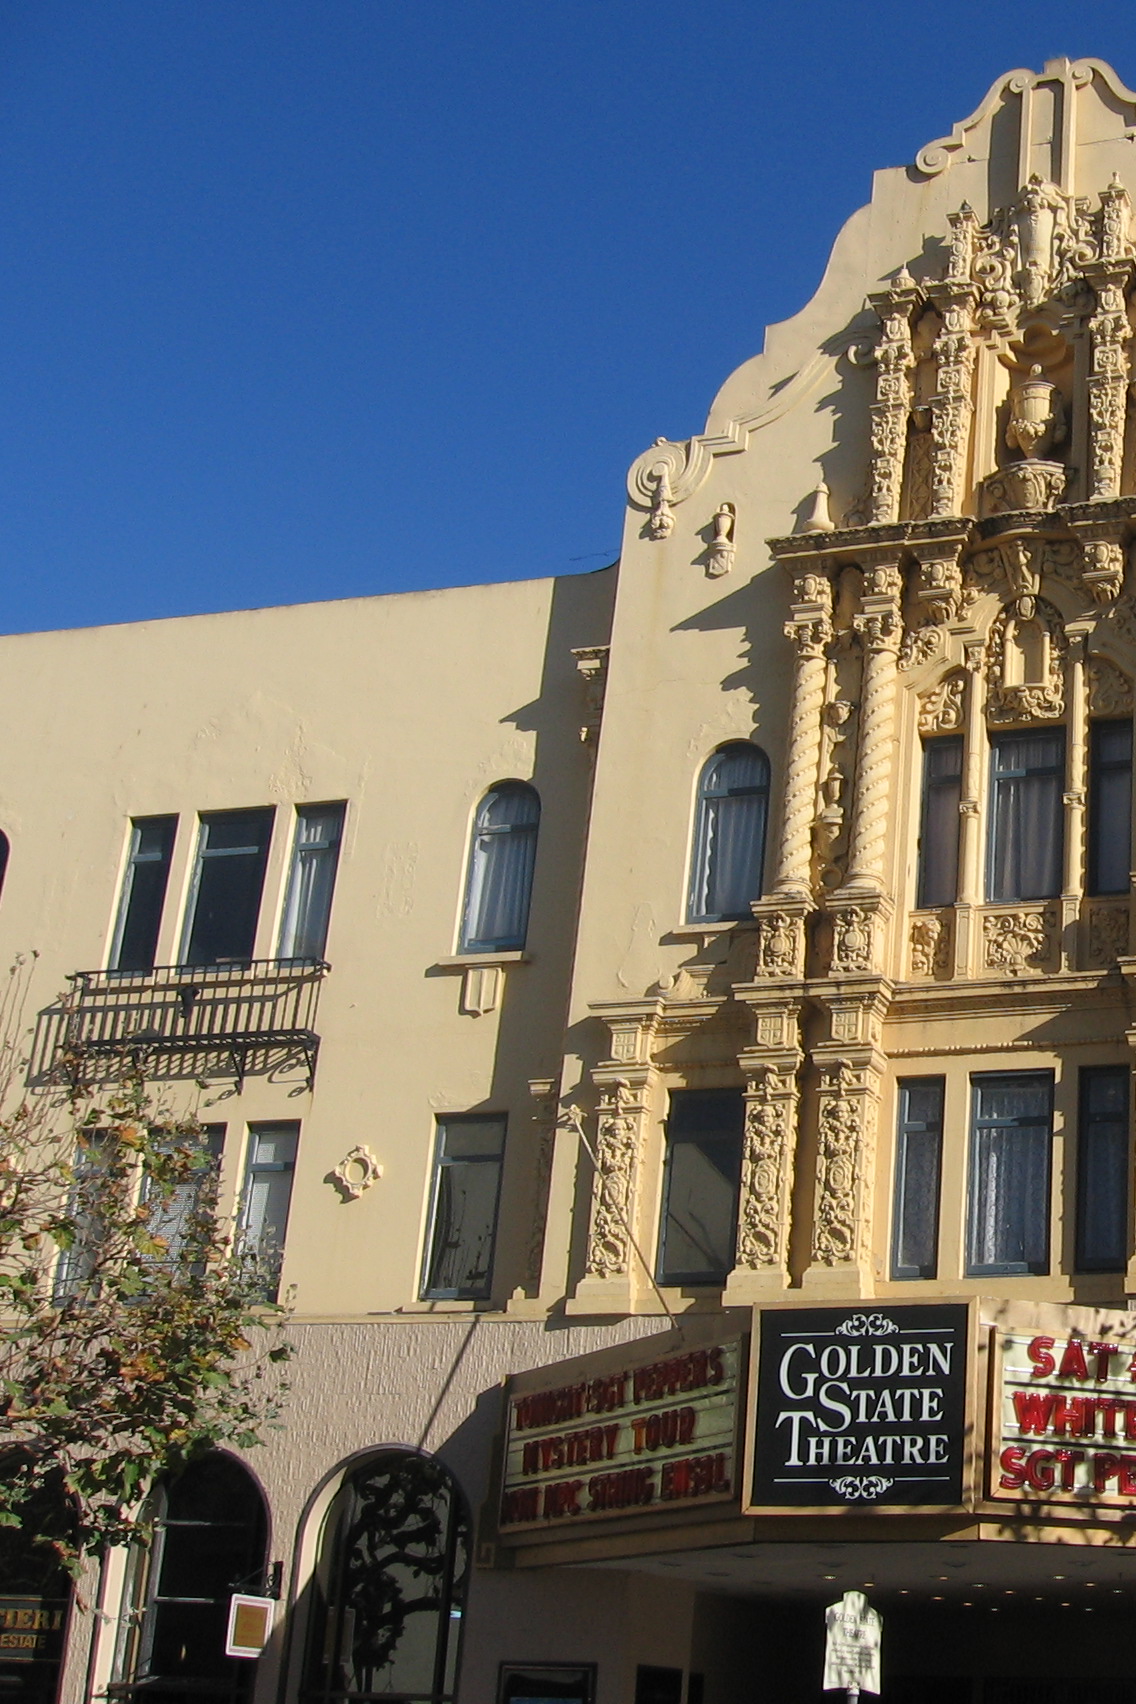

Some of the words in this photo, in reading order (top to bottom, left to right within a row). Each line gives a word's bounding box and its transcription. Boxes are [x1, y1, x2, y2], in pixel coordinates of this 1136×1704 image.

[779, 1343, 954, 1400] GOLDEN
[1028, 1336, 1119, 1384] SAT
[817, 1381, 944, 1433] STATE
[522, 1423, 620, 1477] MYSTERY
[631, 1405, 697, 1456] TOUR
[775, 1411, 950, 1467] THEATRE
[999, 1445, 1084, 1491] SGT
[0, 1608, 63, 1630] IERI
